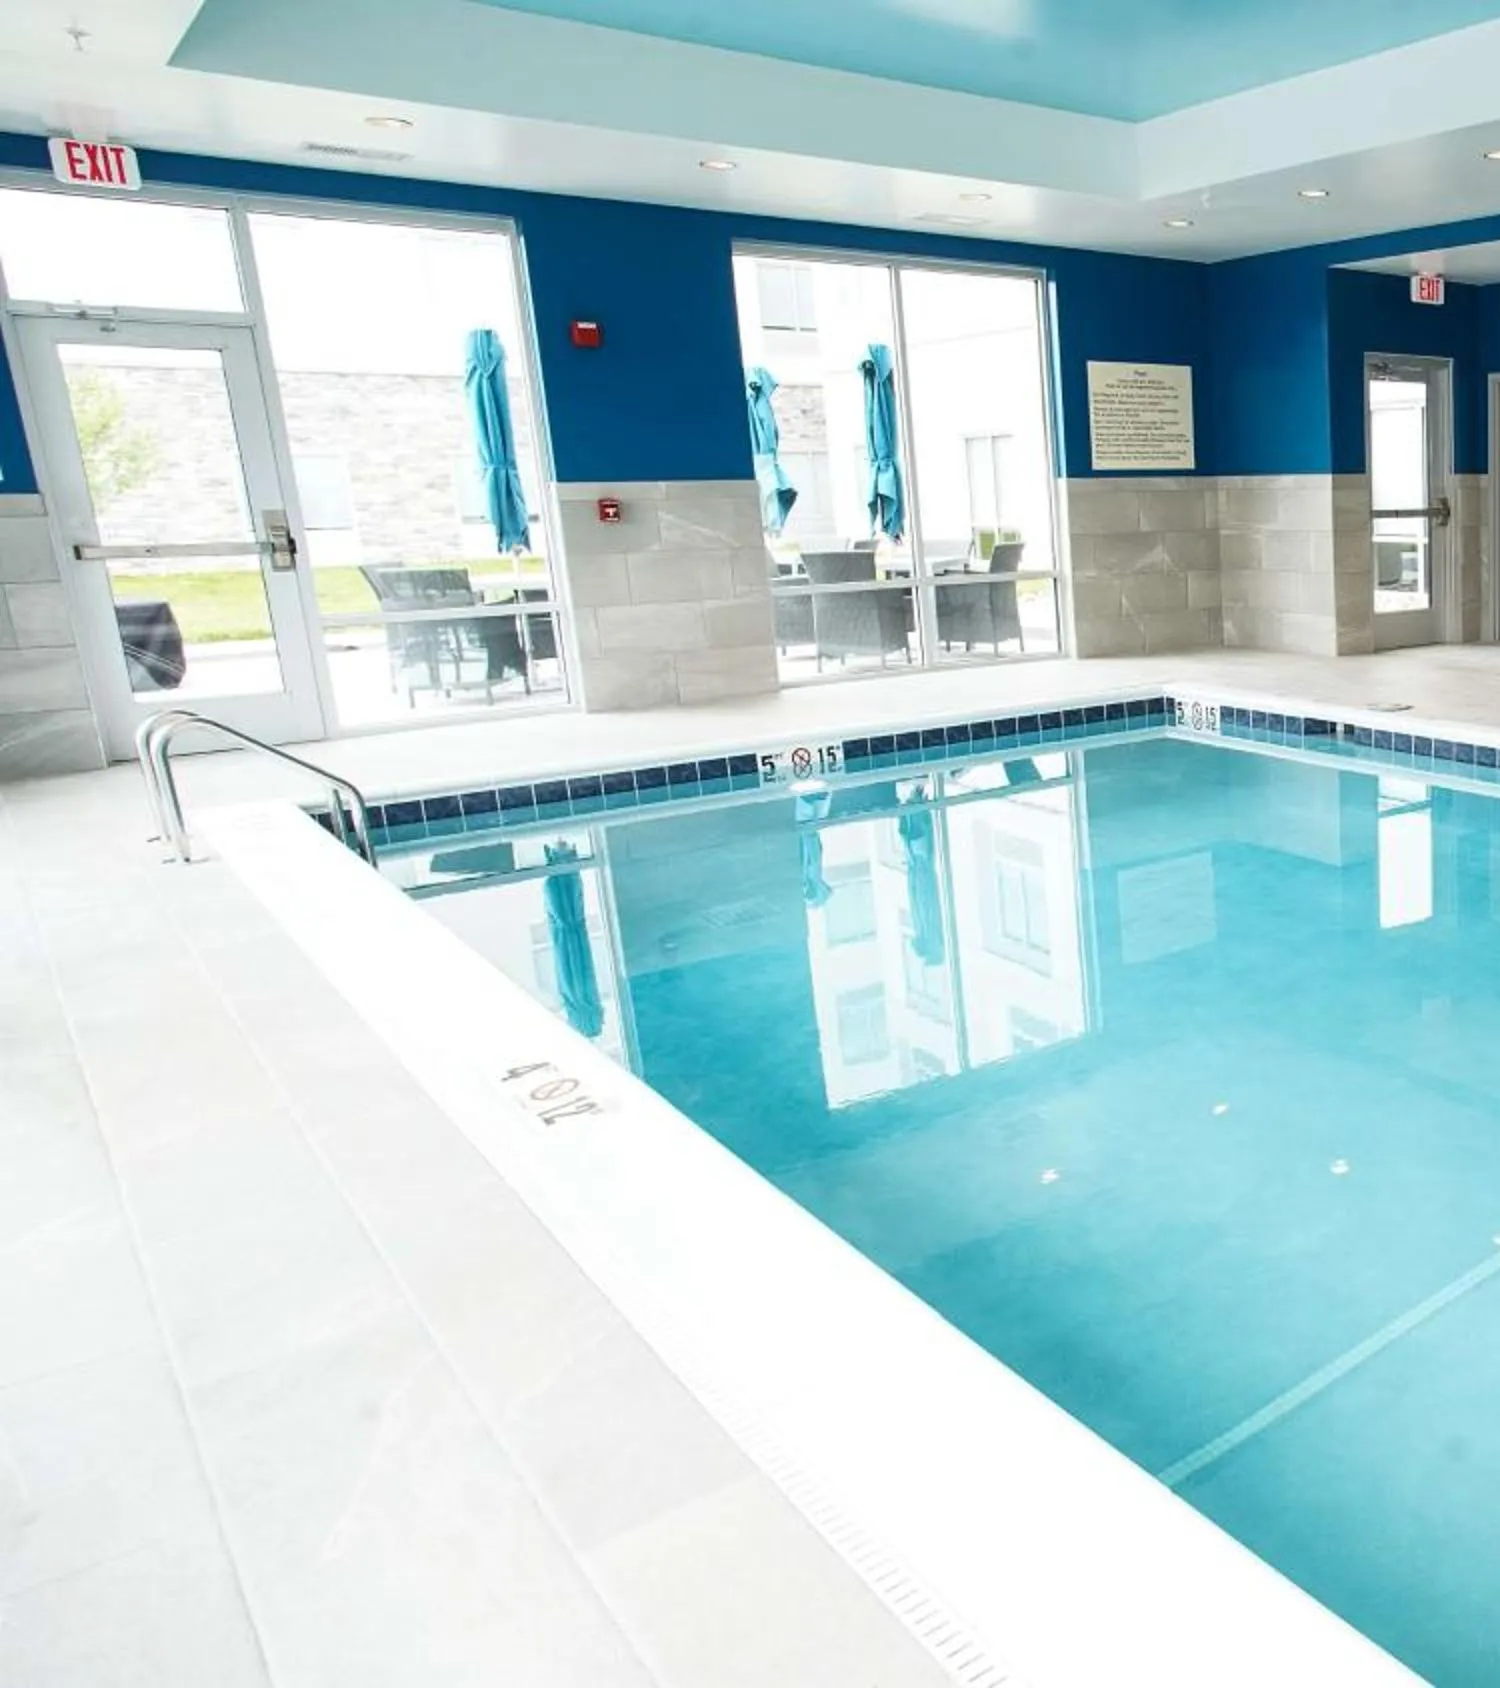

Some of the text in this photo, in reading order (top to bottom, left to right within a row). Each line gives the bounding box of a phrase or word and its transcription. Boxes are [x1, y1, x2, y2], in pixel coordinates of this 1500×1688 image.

[64, 141, 127, 184] EXIT
[501, 1062, 550, 1082] 4
[536, 1096, 598, 1125] 12
